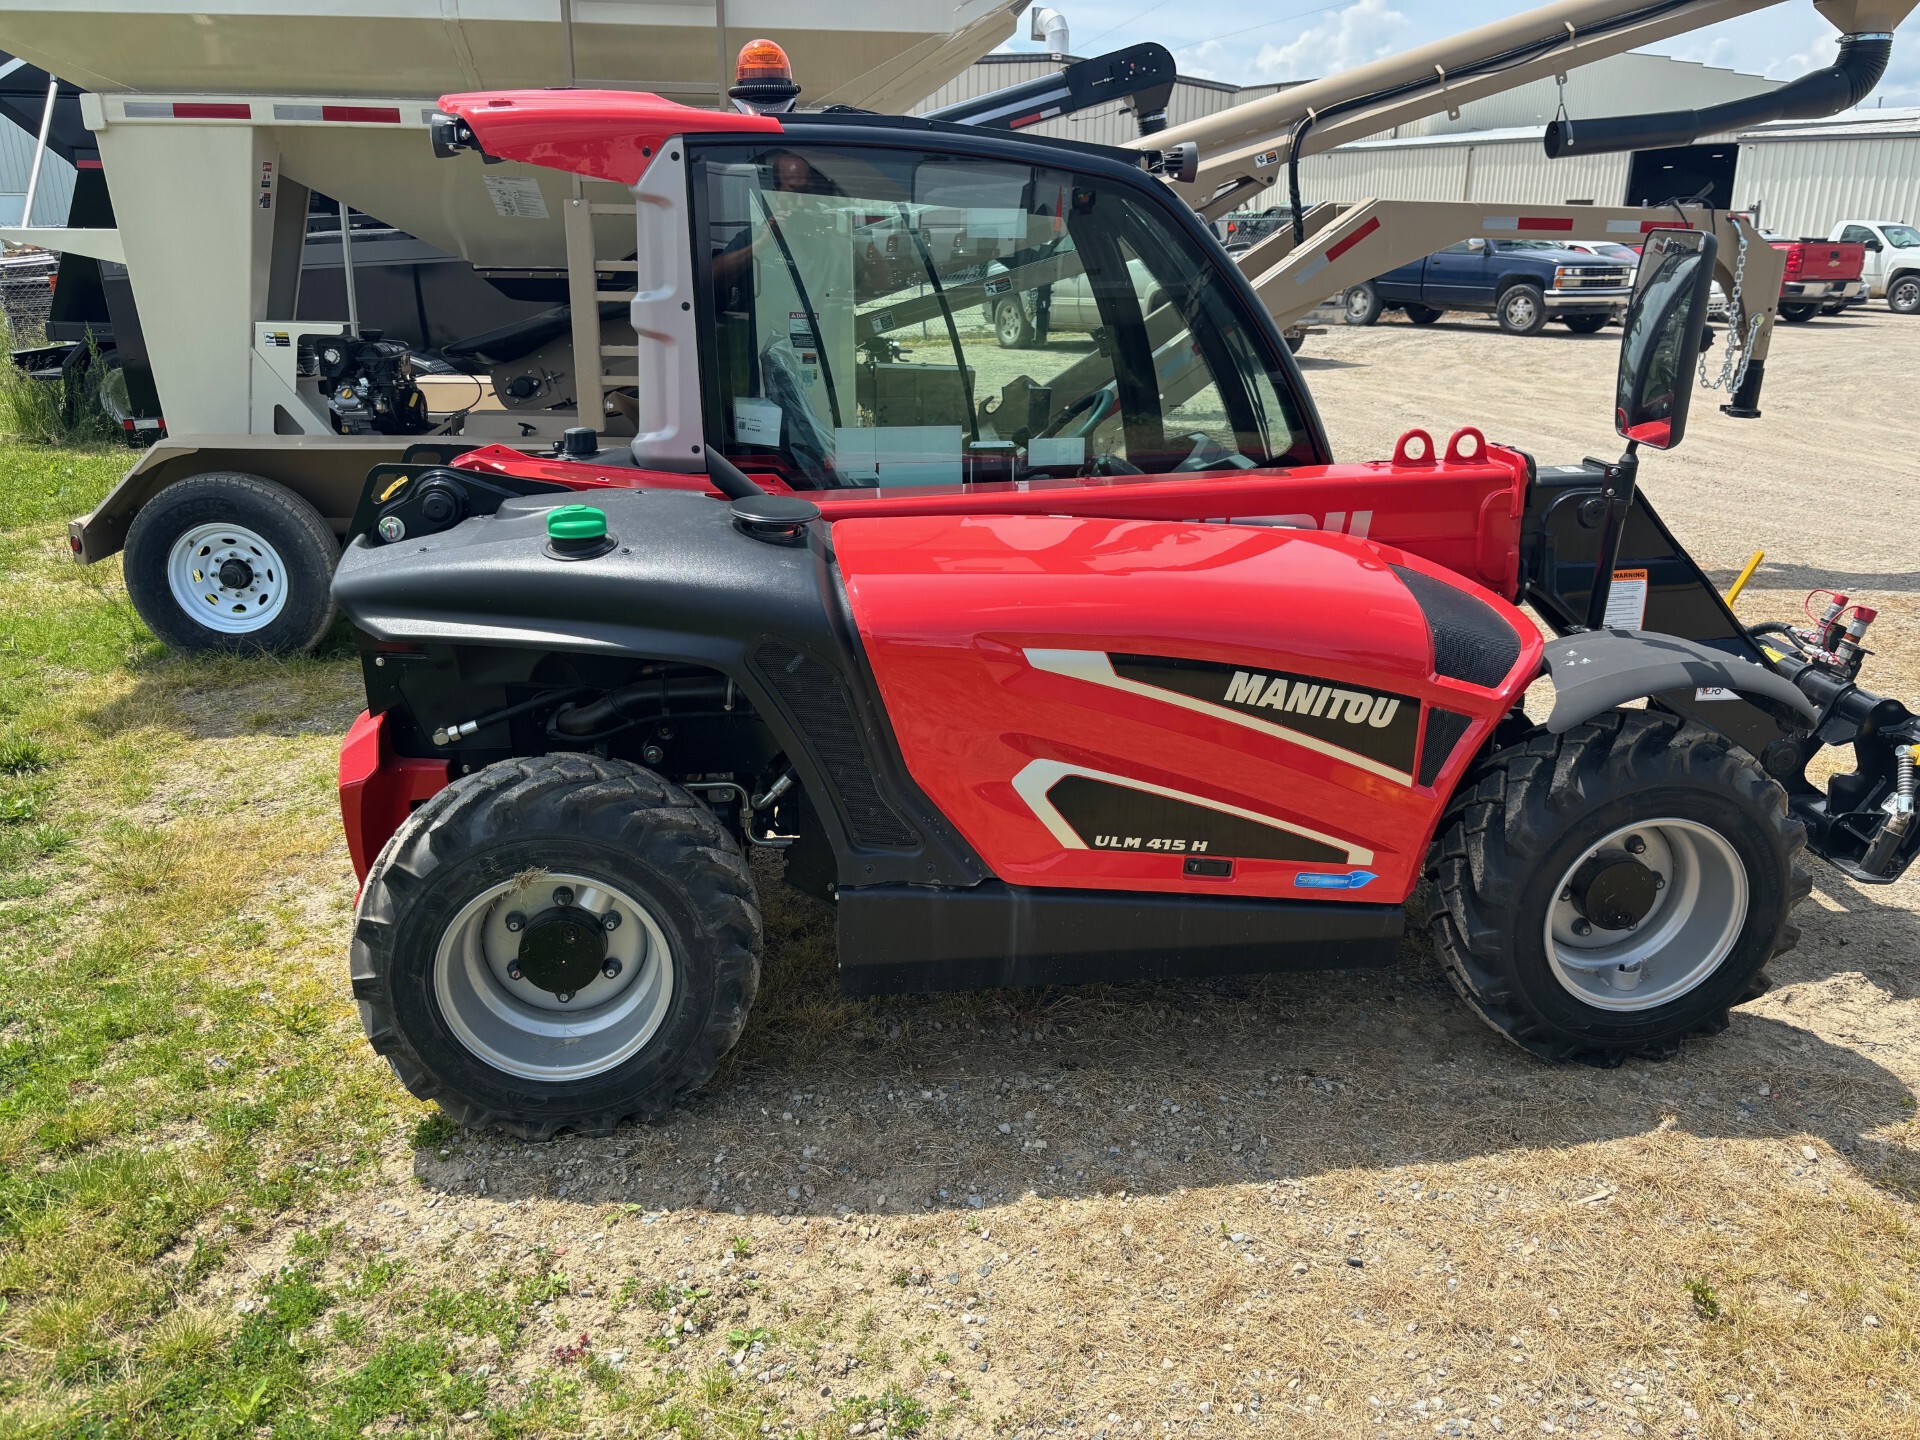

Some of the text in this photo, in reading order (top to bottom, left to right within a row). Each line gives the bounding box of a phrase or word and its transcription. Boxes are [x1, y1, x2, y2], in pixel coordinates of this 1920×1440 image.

[1613, 571, 1645, 579] WARNING
[1223, 670, 1400, 728] MANITOU
[1094, 835, 1208, 852] ULM 415 H
